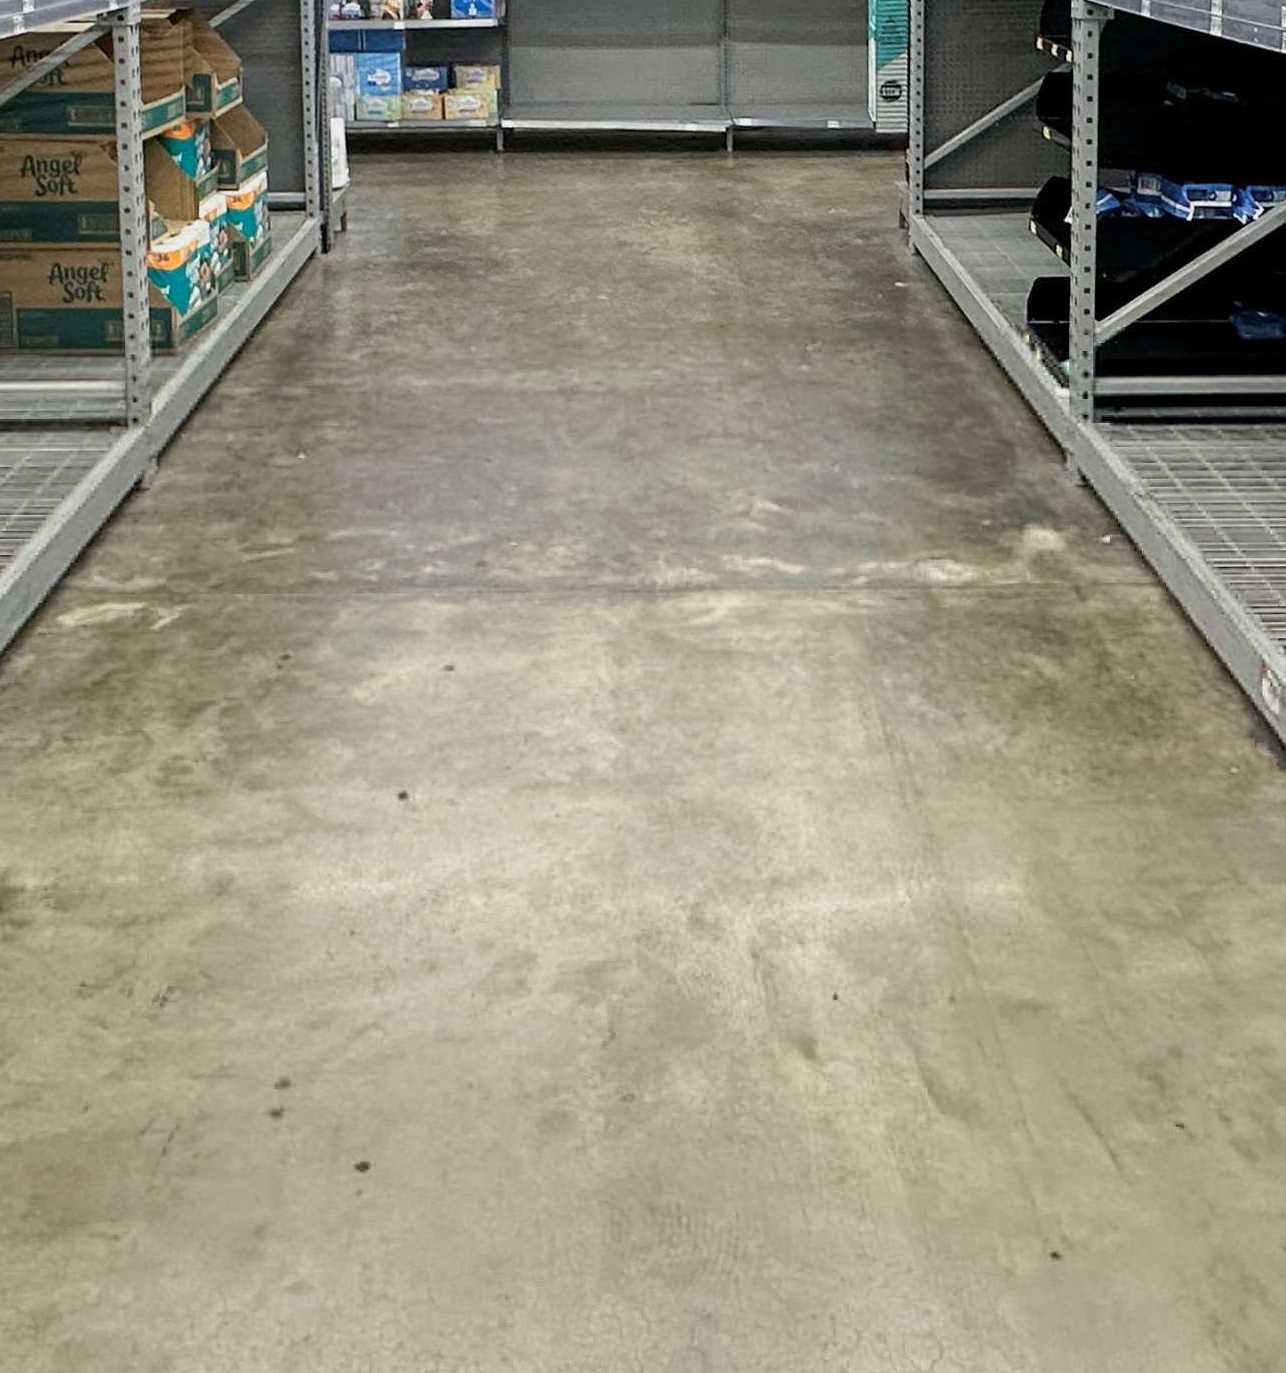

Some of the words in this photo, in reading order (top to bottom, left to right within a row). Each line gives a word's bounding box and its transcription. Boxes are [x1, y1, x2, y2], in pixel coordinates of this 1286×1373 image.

[20, 152, 82, 178] Angel
[34, 177, 80, 198] Soft
[48, 261, 110, 286] Angel
[63, 281, 105, 303] Soft
